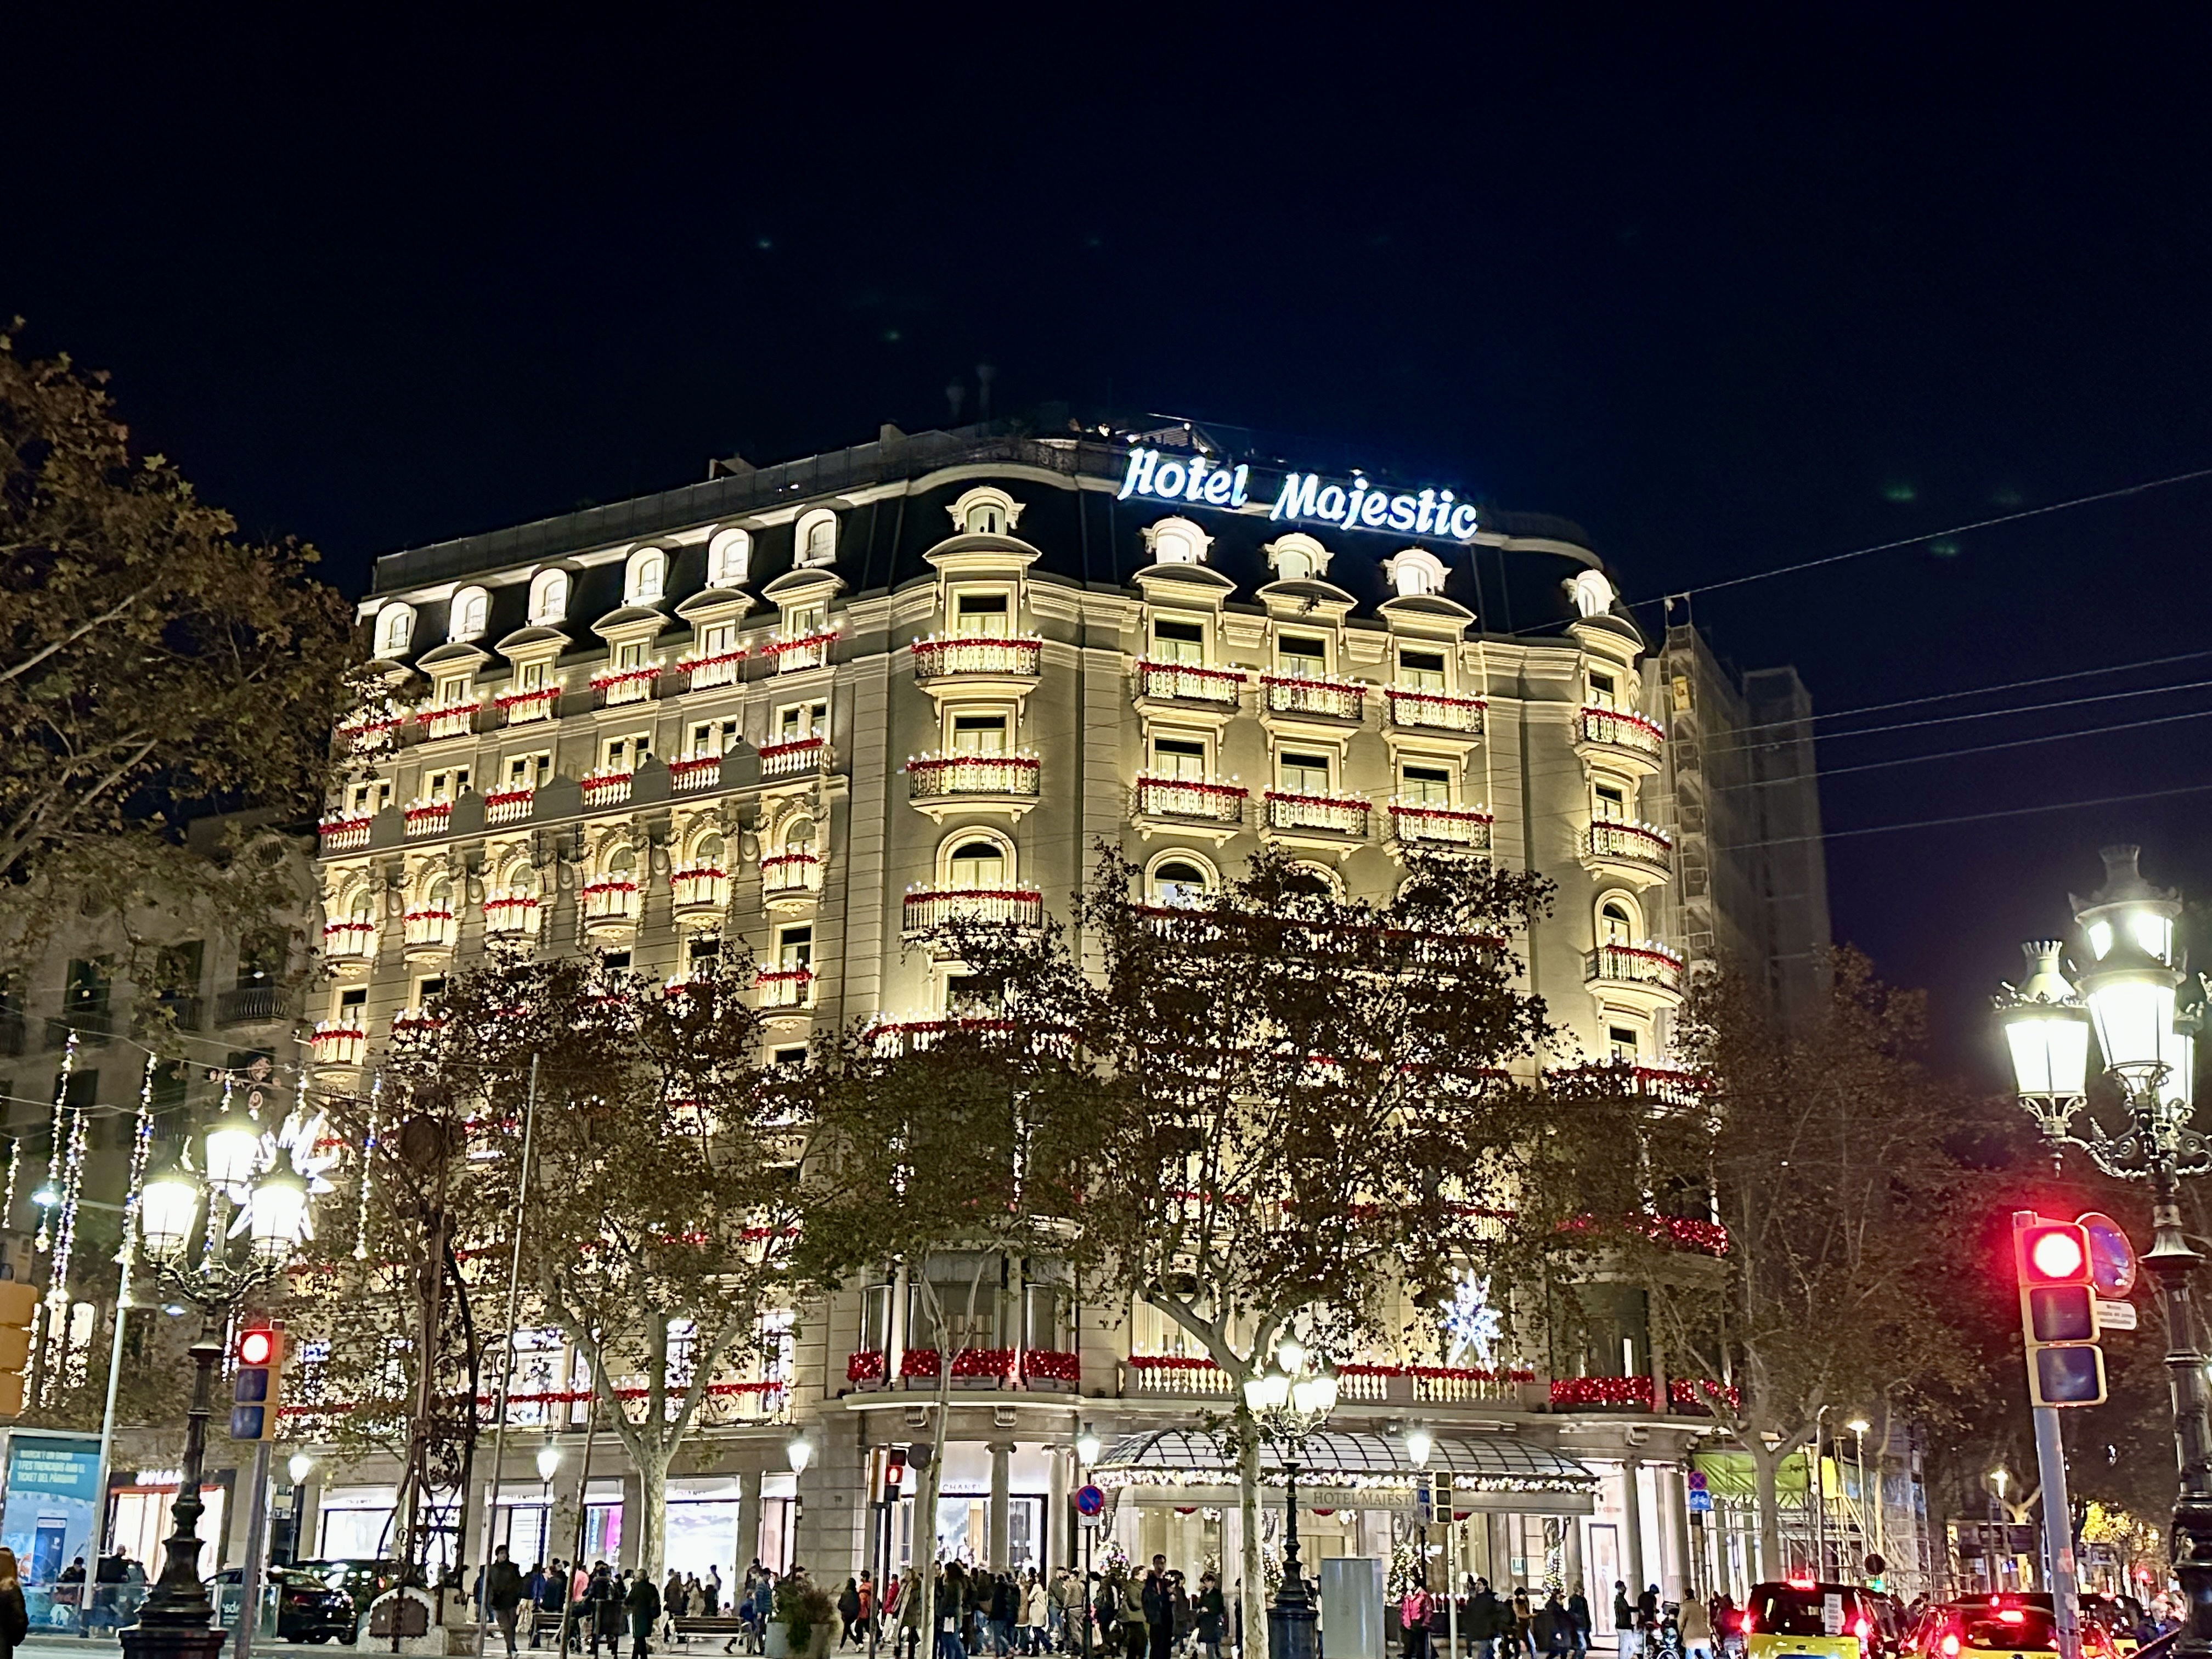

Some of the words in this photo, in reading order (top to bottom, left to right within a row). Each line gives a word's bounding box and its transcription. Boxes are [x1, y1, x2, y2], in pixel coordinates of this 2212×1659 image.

[1117, 447, 1249, 507] Hotel
[1269, 472, 1479, 539] Majestic
[1313, 1492, 1358, 1505] HOTEL
[1361, 1492, 1416, 1507] MAJESTI
